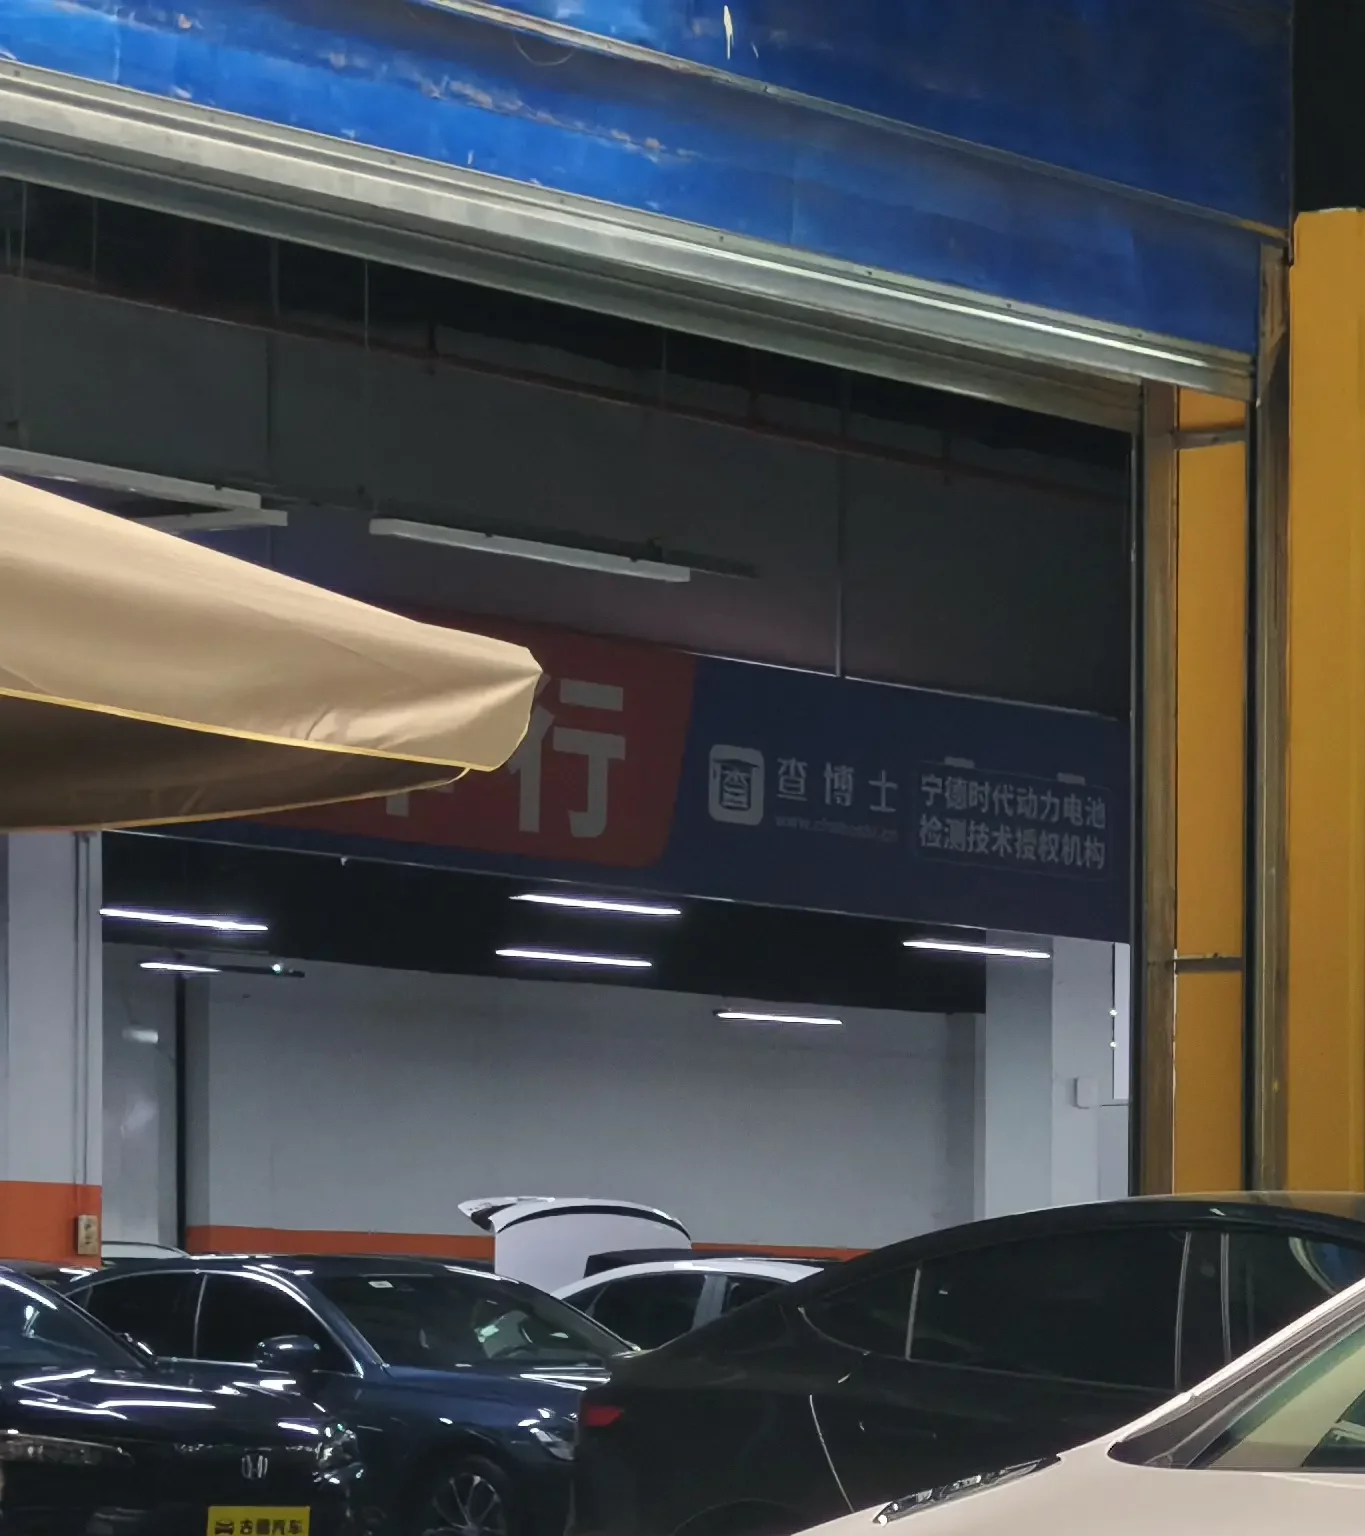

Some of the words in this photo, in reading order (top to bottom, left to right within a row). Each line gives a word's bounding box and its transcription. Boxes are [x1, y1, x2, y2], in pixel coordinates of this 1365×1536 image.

[776, 757, 899, 814] 查博士
[920, 773, 1107, 830] 宁德时代动力电池
[919, 813, 1107, 870] 检测技术授权机构
